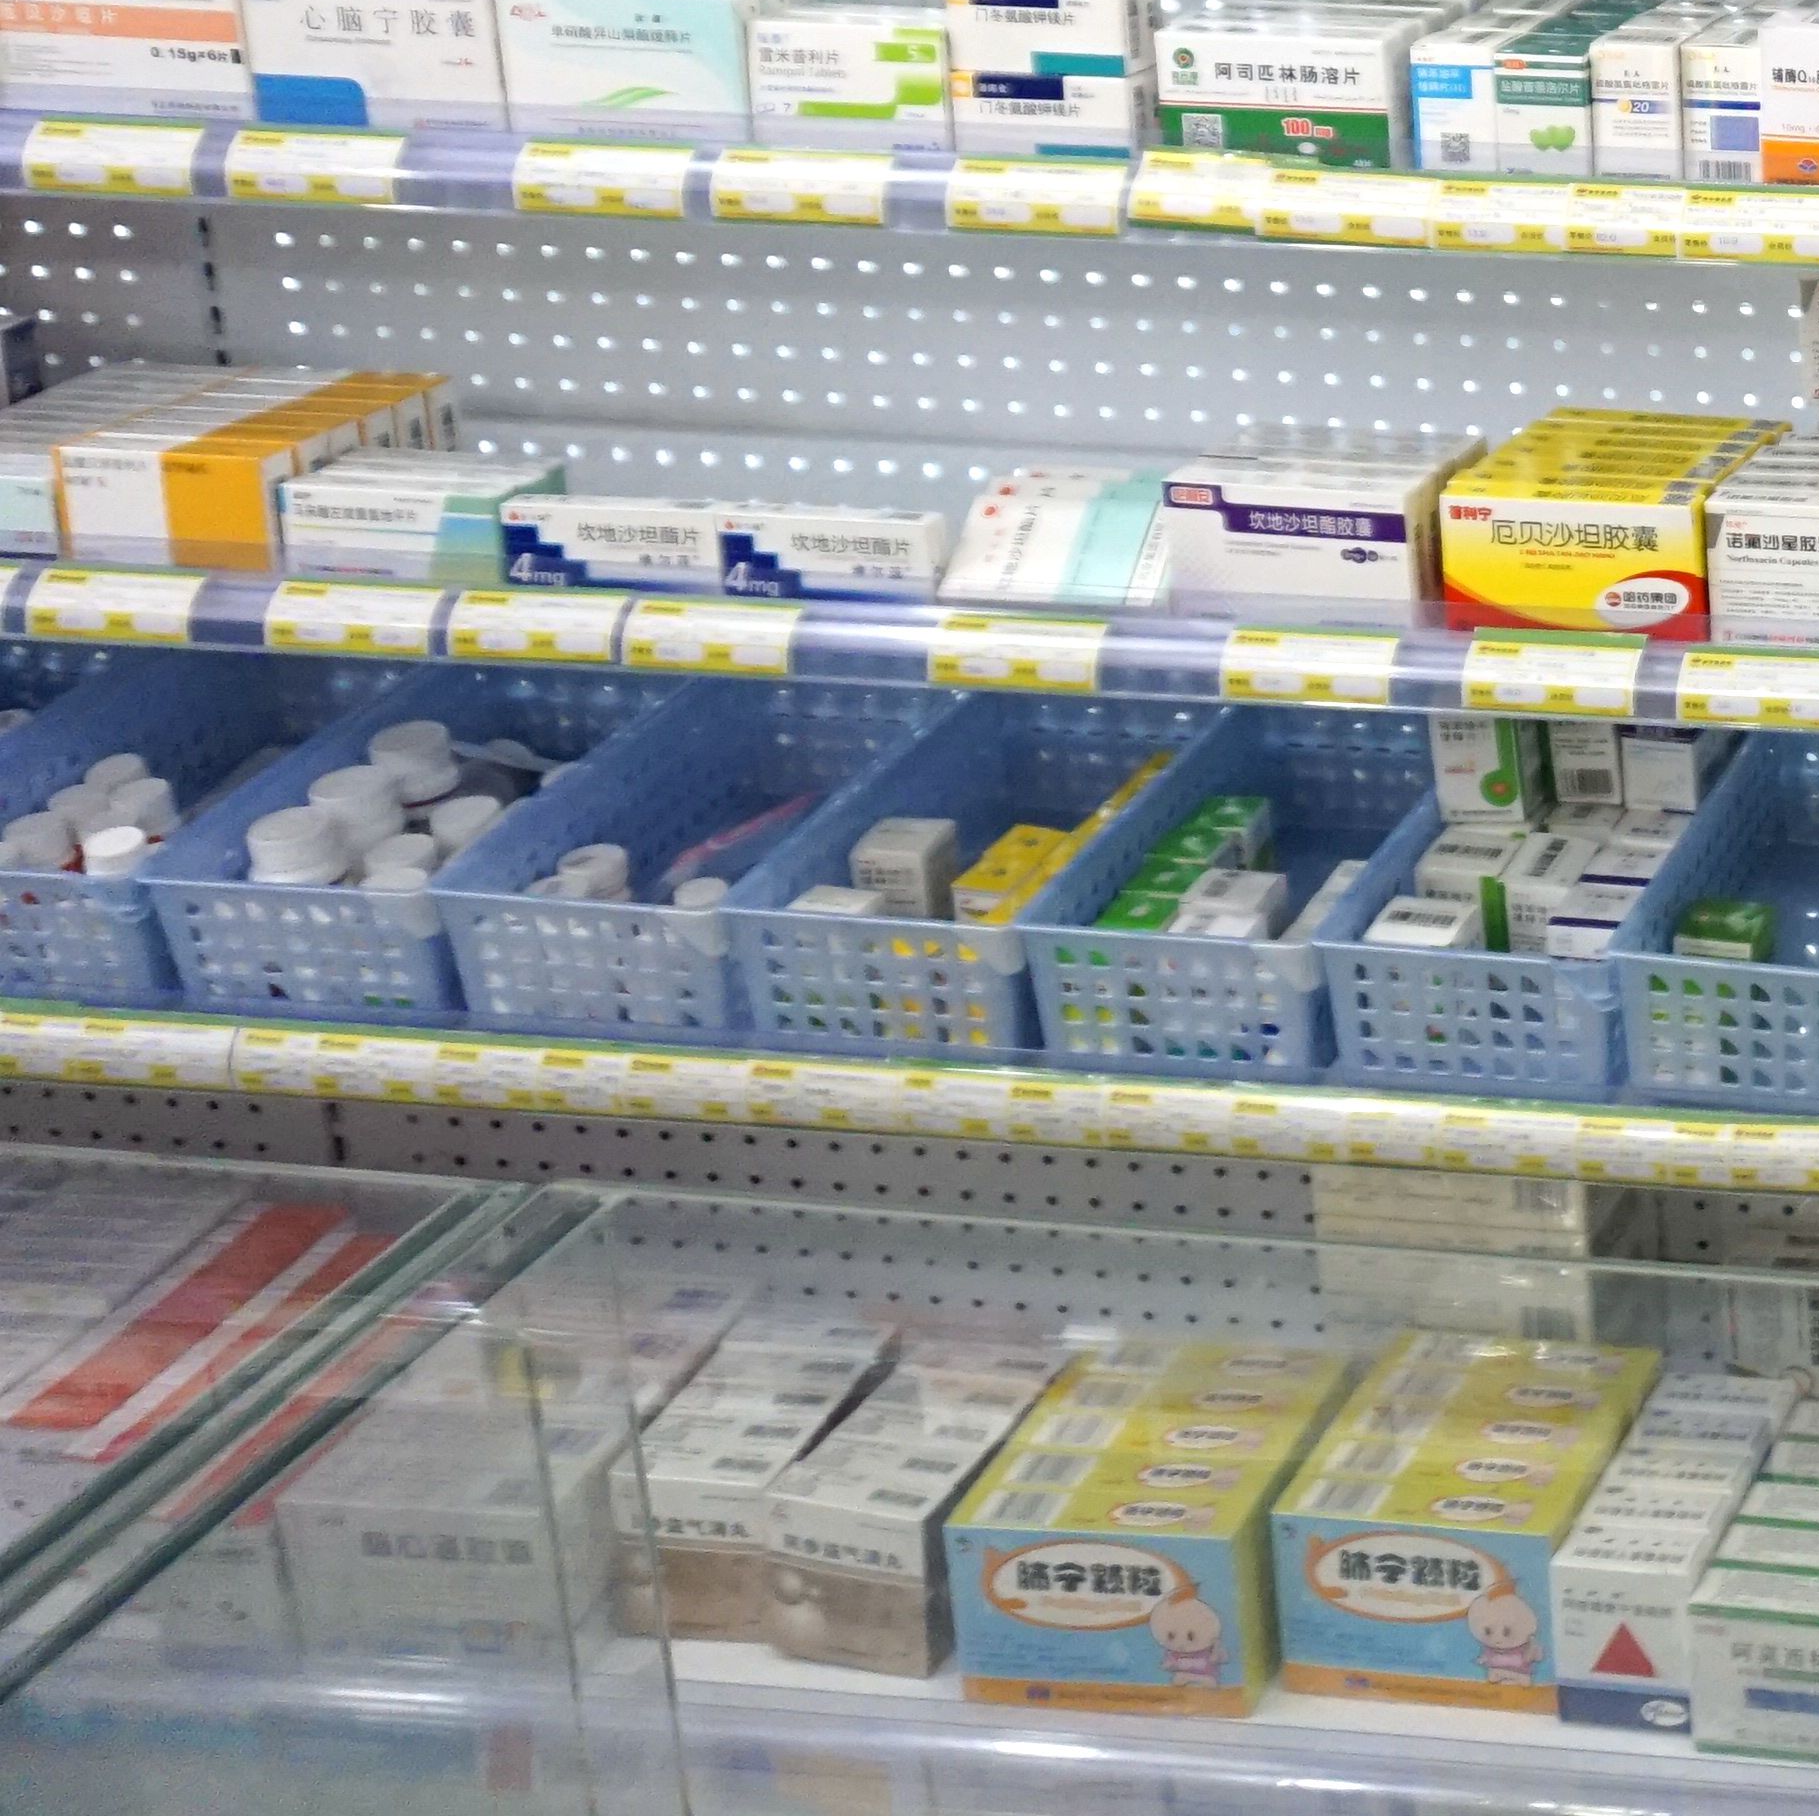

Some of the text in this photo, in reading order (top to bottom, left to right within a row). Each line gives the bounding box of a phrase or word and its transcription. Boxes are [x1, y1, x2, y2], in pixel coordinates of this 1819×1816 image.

[300, 4, 476, 38] 心脑宁胶囊
[1214, 60, 1361, 86] 阿司匹林肠溶片
[1248, 510, 1375, 538] 坎地沙坦酯胶囊
[1490, 518, 1660, 553] 厄贝沙坦胶囊
